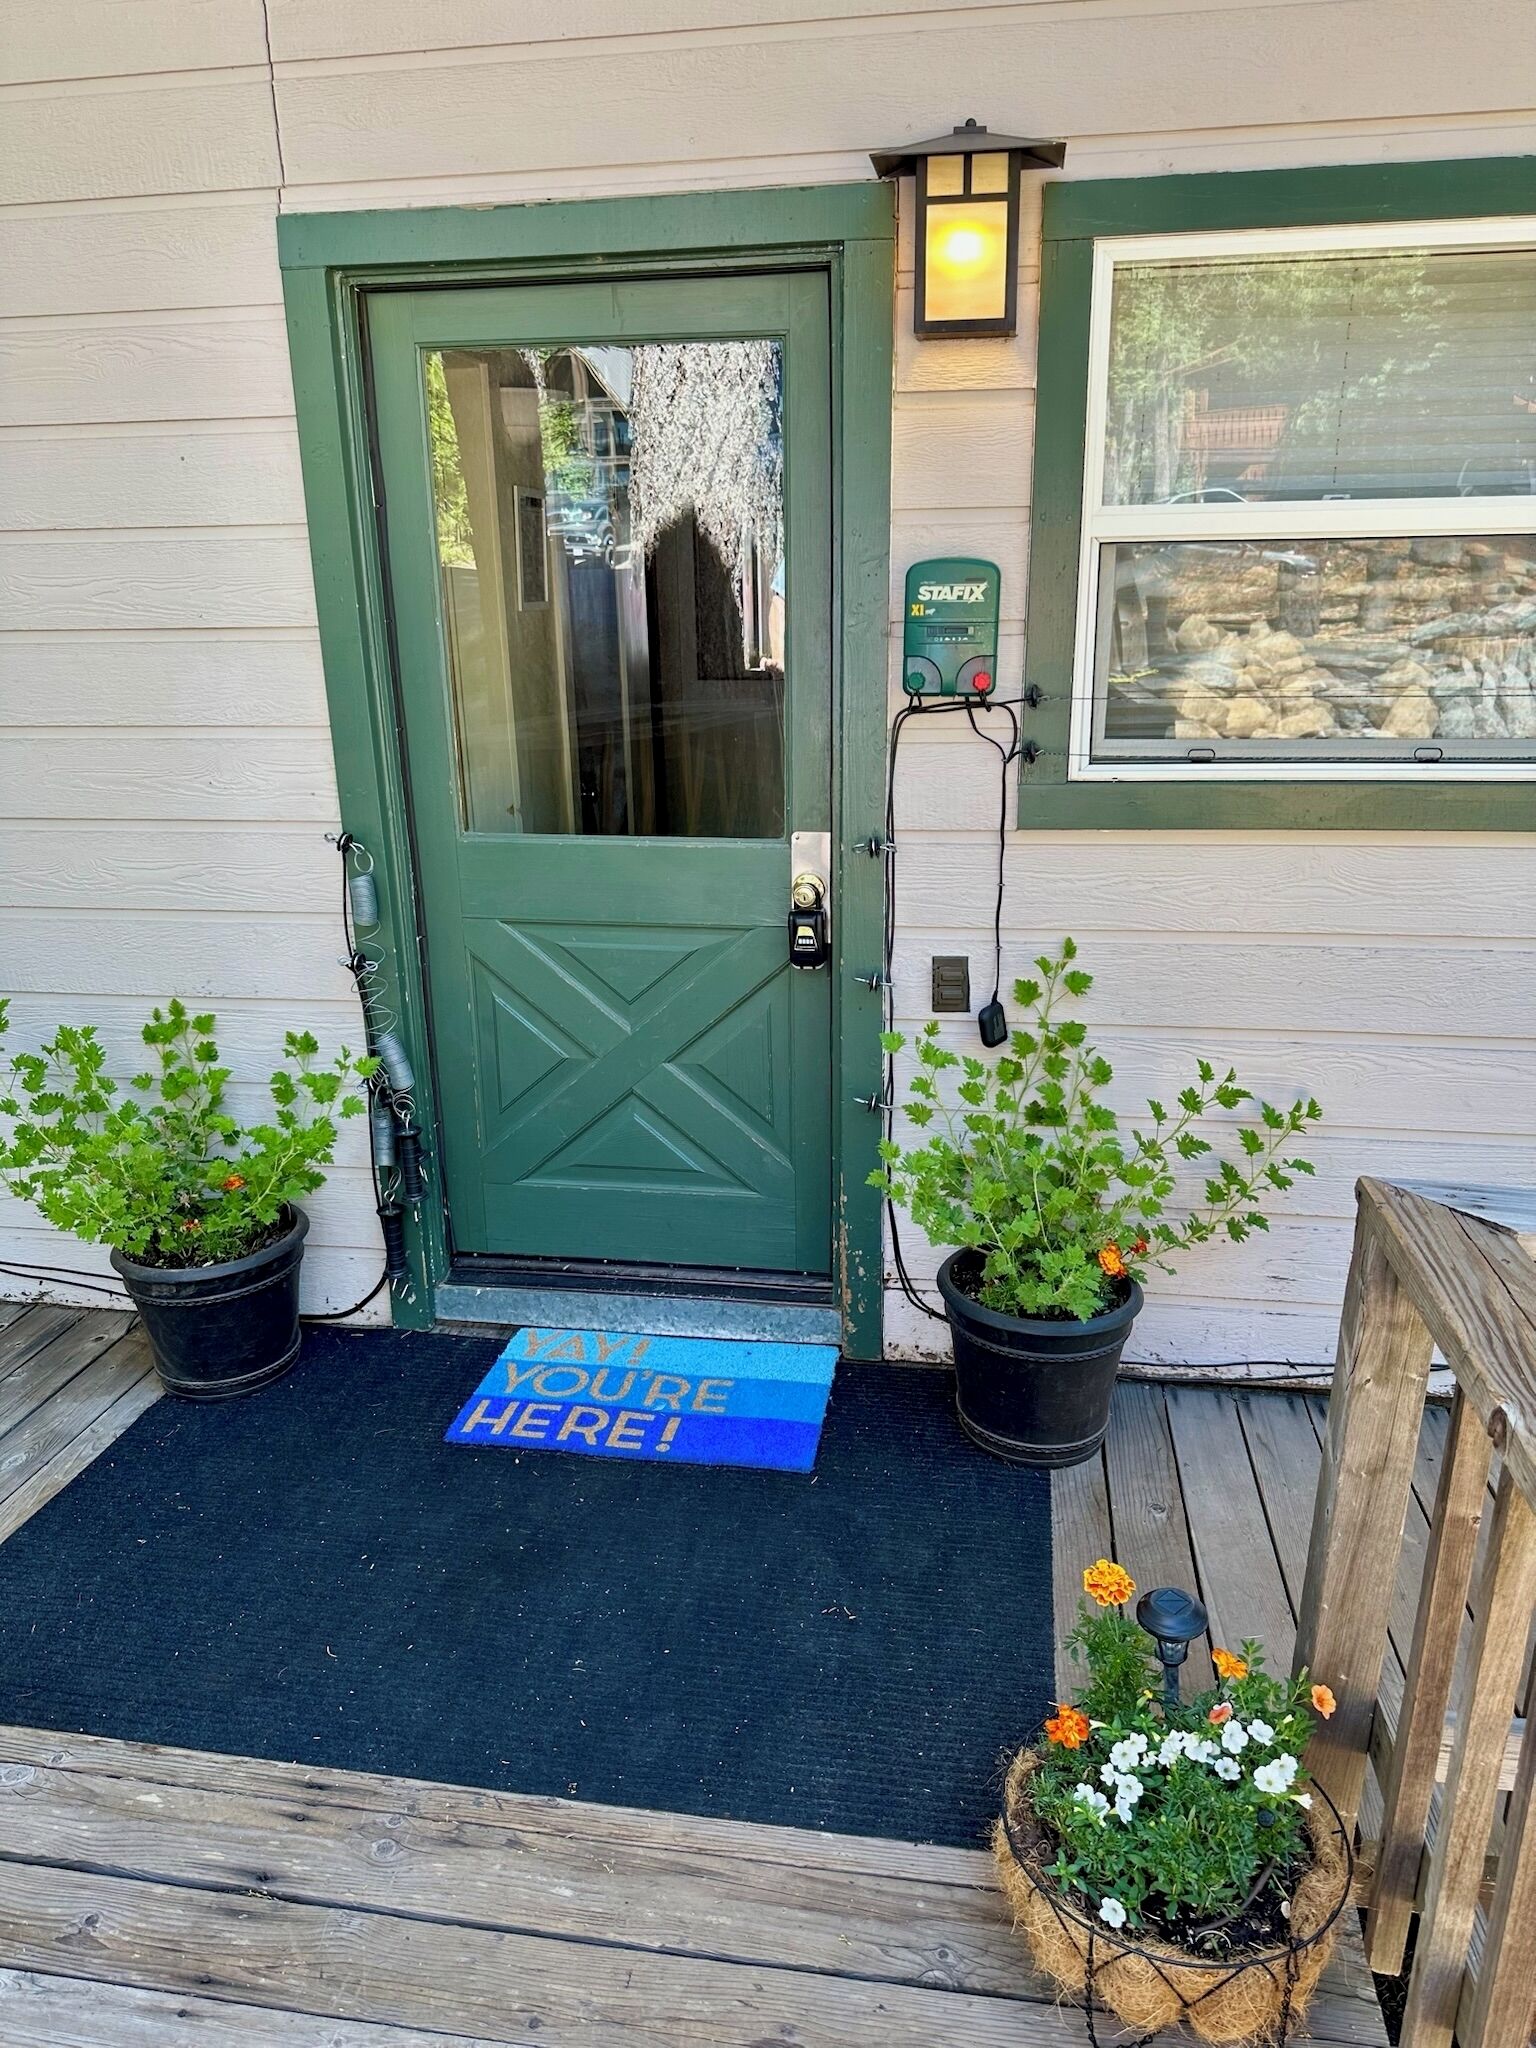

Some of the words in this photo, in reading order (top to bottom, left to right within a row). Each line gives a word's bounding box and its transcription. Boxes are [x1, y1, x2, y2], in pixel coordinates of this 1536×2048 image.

[917, 582, 988, 604] STAFIX
[522, 1329, 651, 1365] YAY!
[503, 1362, 735, 1414] YOU'RE
[460, 1399, 681, 1453] HERE!
